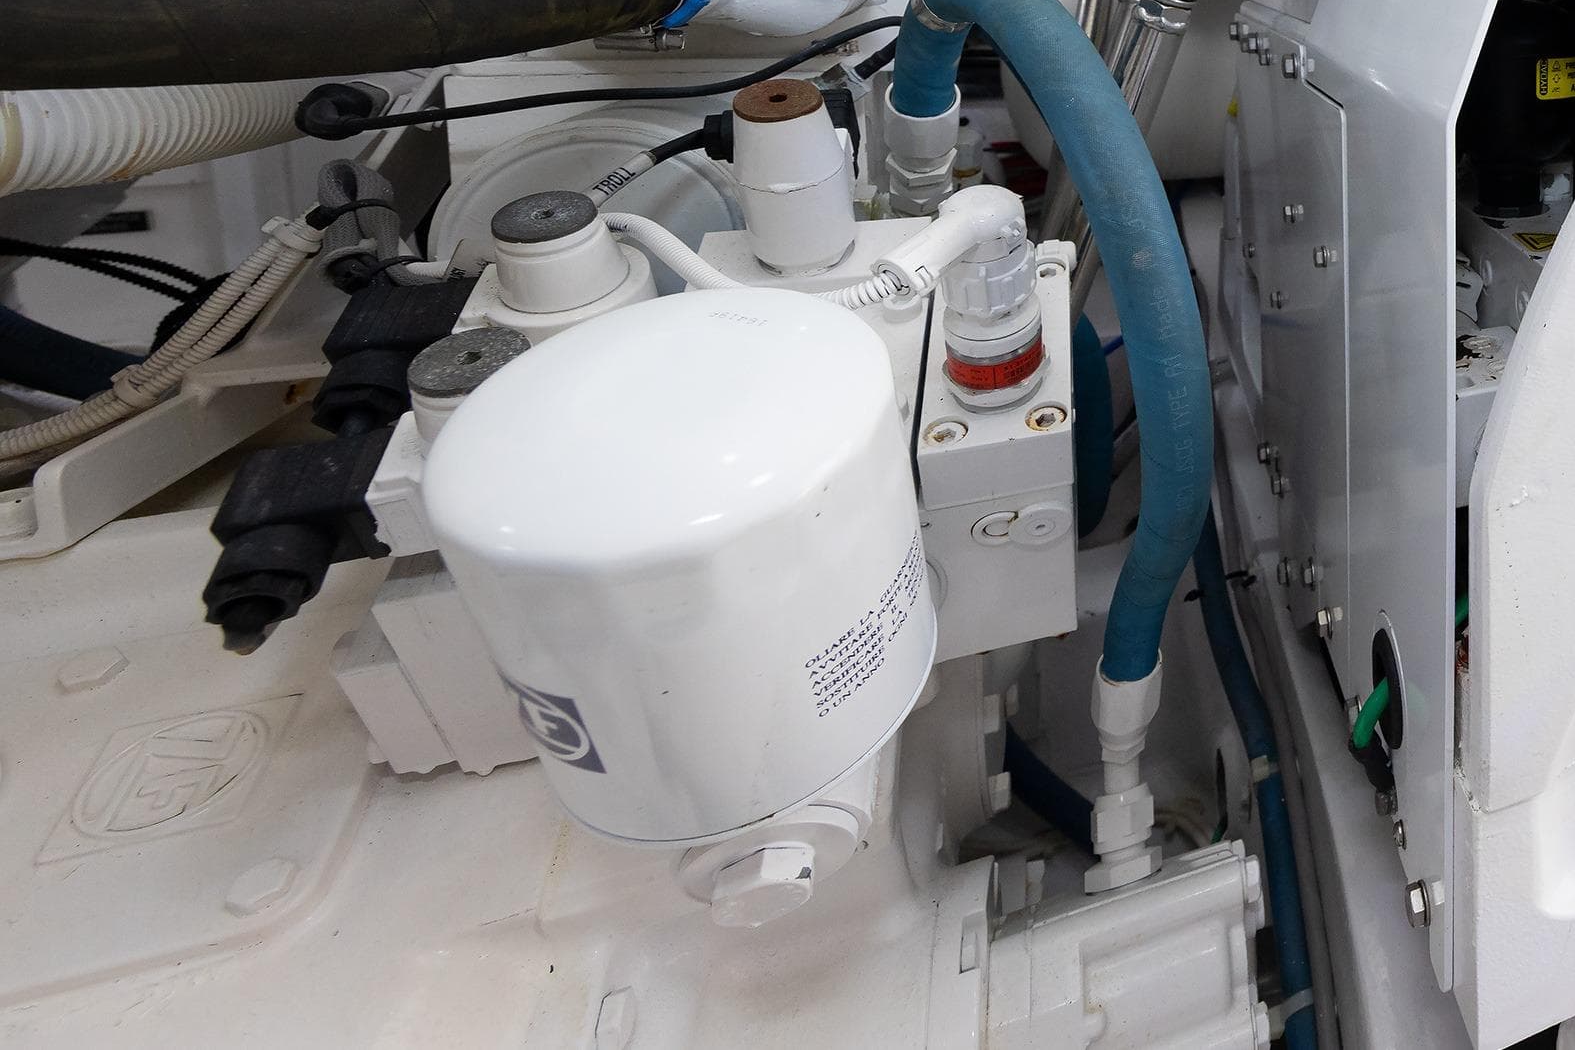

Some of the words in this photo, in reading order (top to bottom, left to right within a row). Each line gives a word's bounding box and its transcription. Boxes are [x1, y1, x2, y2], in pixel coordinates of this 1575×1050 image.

[592, 167, 636, 196] TROLL
[805, 627, 856, 668] OLIARE
[860, 610, 875, 625] LA
[809, 622, 874, 679] AVVITARE
[812, 623, 884, 689] ACCENDERE
[814, 634, 885, 698] VERIFICARE
[892, 610, 902, 625] LA
[816, 647, 885, 709] SOSTITUIRE
[818, 708, 830, 718] O
[832, 693, 854, 708] UN
[854, 657, 885, 691] ANNO
